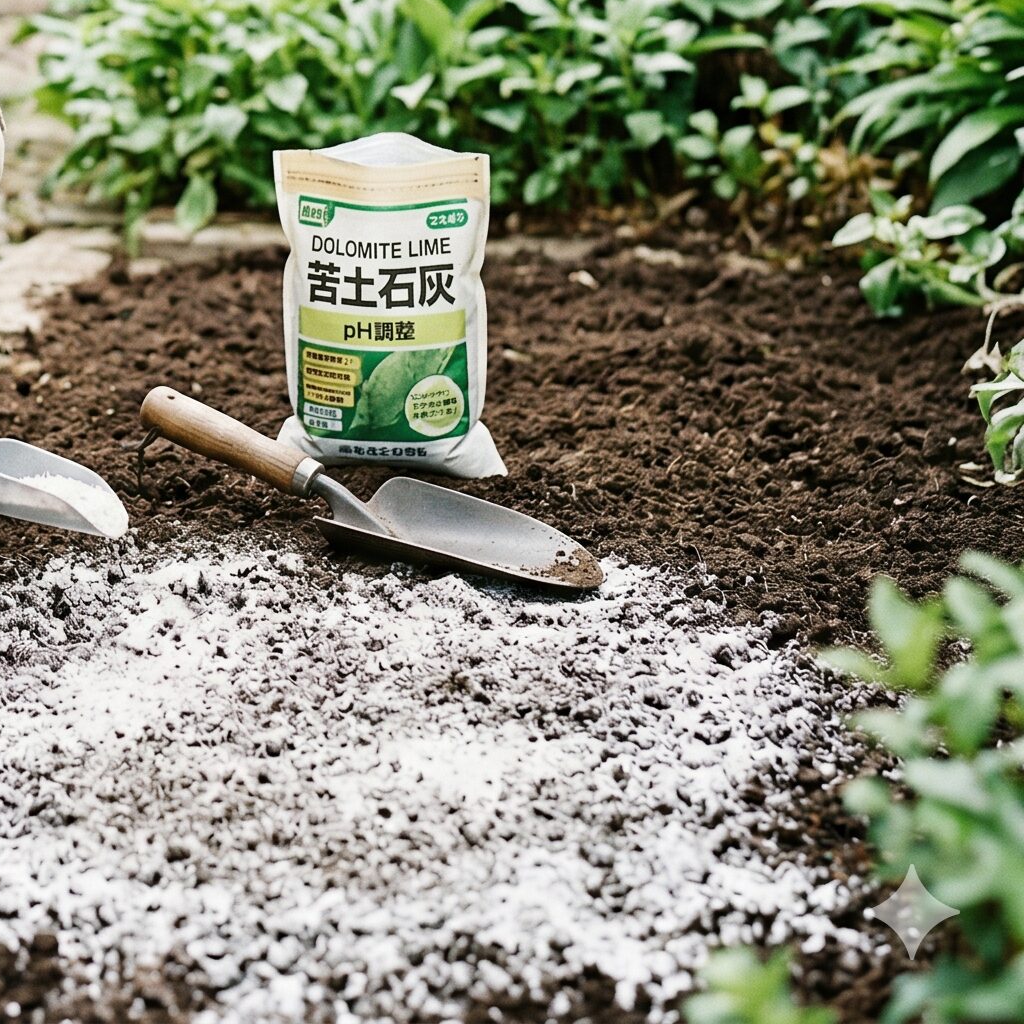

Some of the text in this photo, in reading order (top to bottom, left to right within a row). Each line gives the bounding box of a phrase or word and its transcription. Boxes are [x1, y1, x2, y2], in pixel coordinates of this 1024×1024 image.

[311, 235, 451, 259] DOLOMITE LIME
[307, 260, 456, 309] 苦土石灰
[343, 320, 415, 342] pH調整
